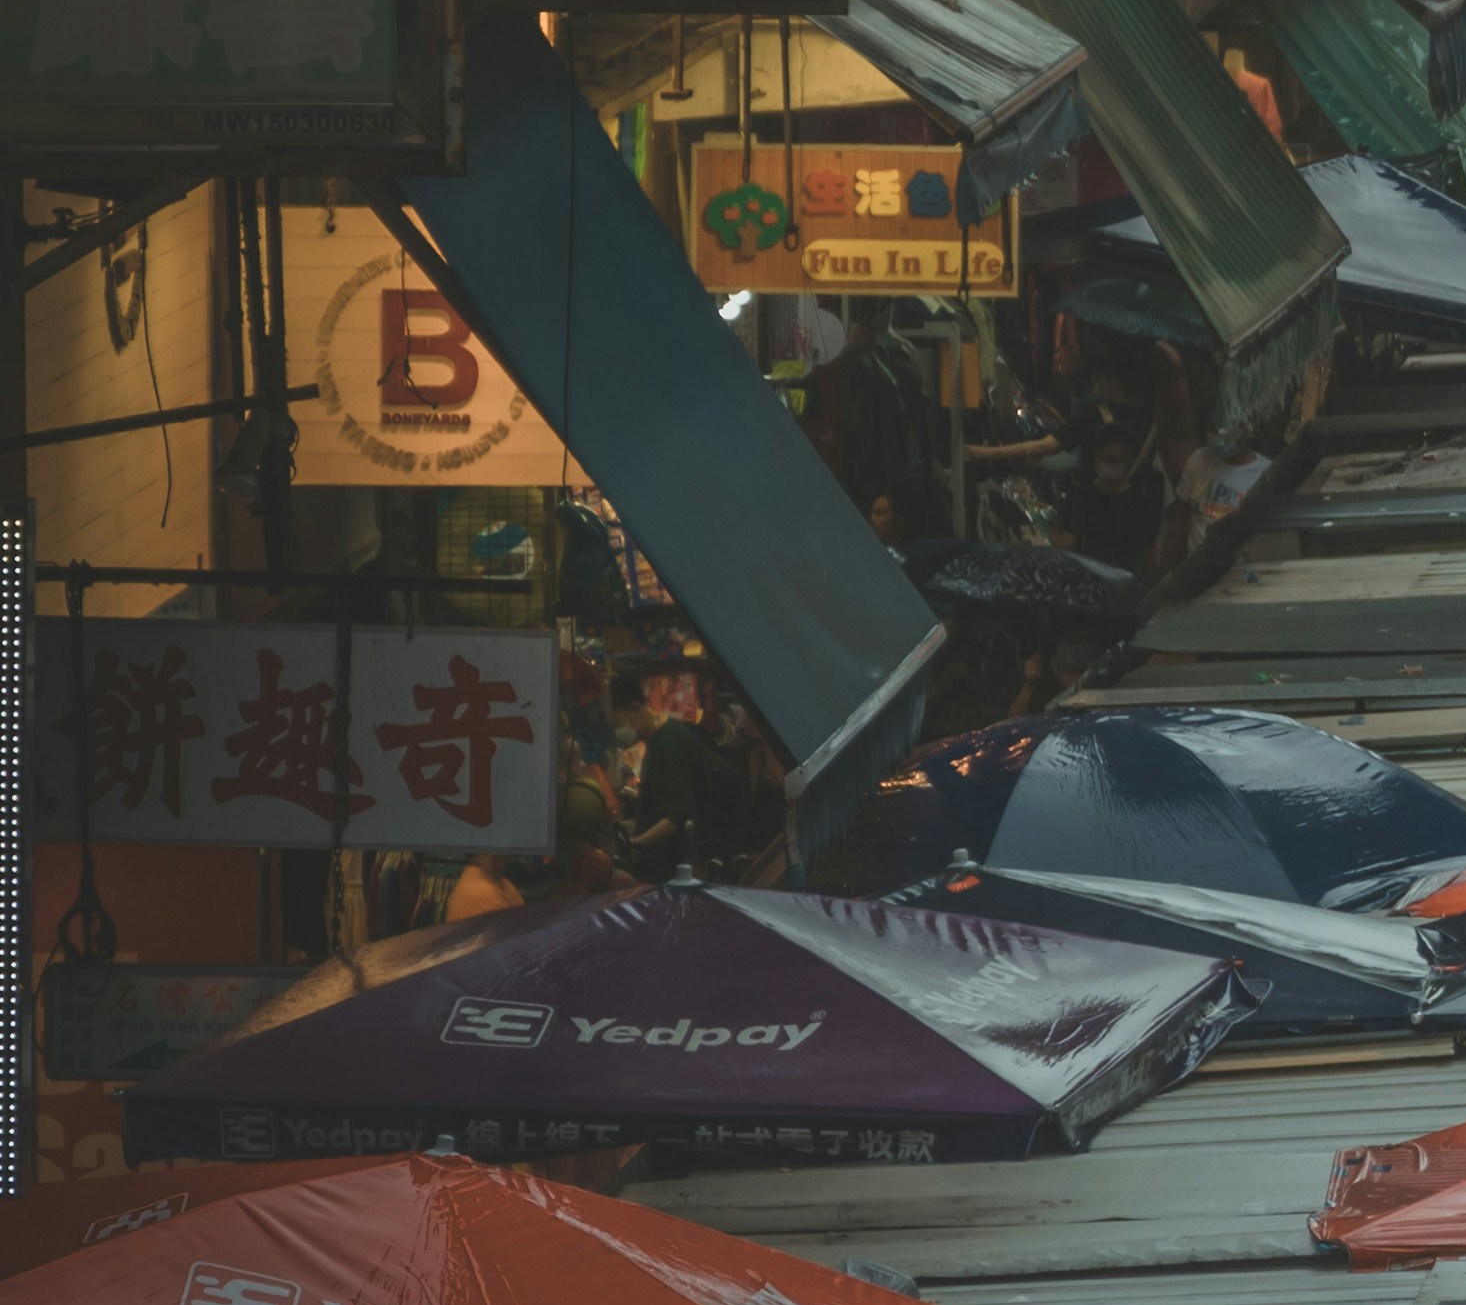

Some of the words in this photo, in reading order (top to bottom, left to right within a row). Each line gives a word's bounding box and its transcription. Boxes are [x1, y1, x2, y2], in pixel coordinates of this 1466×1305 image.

[203, 110, 395, 134] MW150300630
[808, 250, 875, 275] Fun
[887, 251, 922, 275] In
[935, 251, 1003, 276] Lfe
[383, 289, 479, 406] B
[382, 413, 471, 427] BONEYARDS
[572, 1016, 824, 1051] Yedpay
